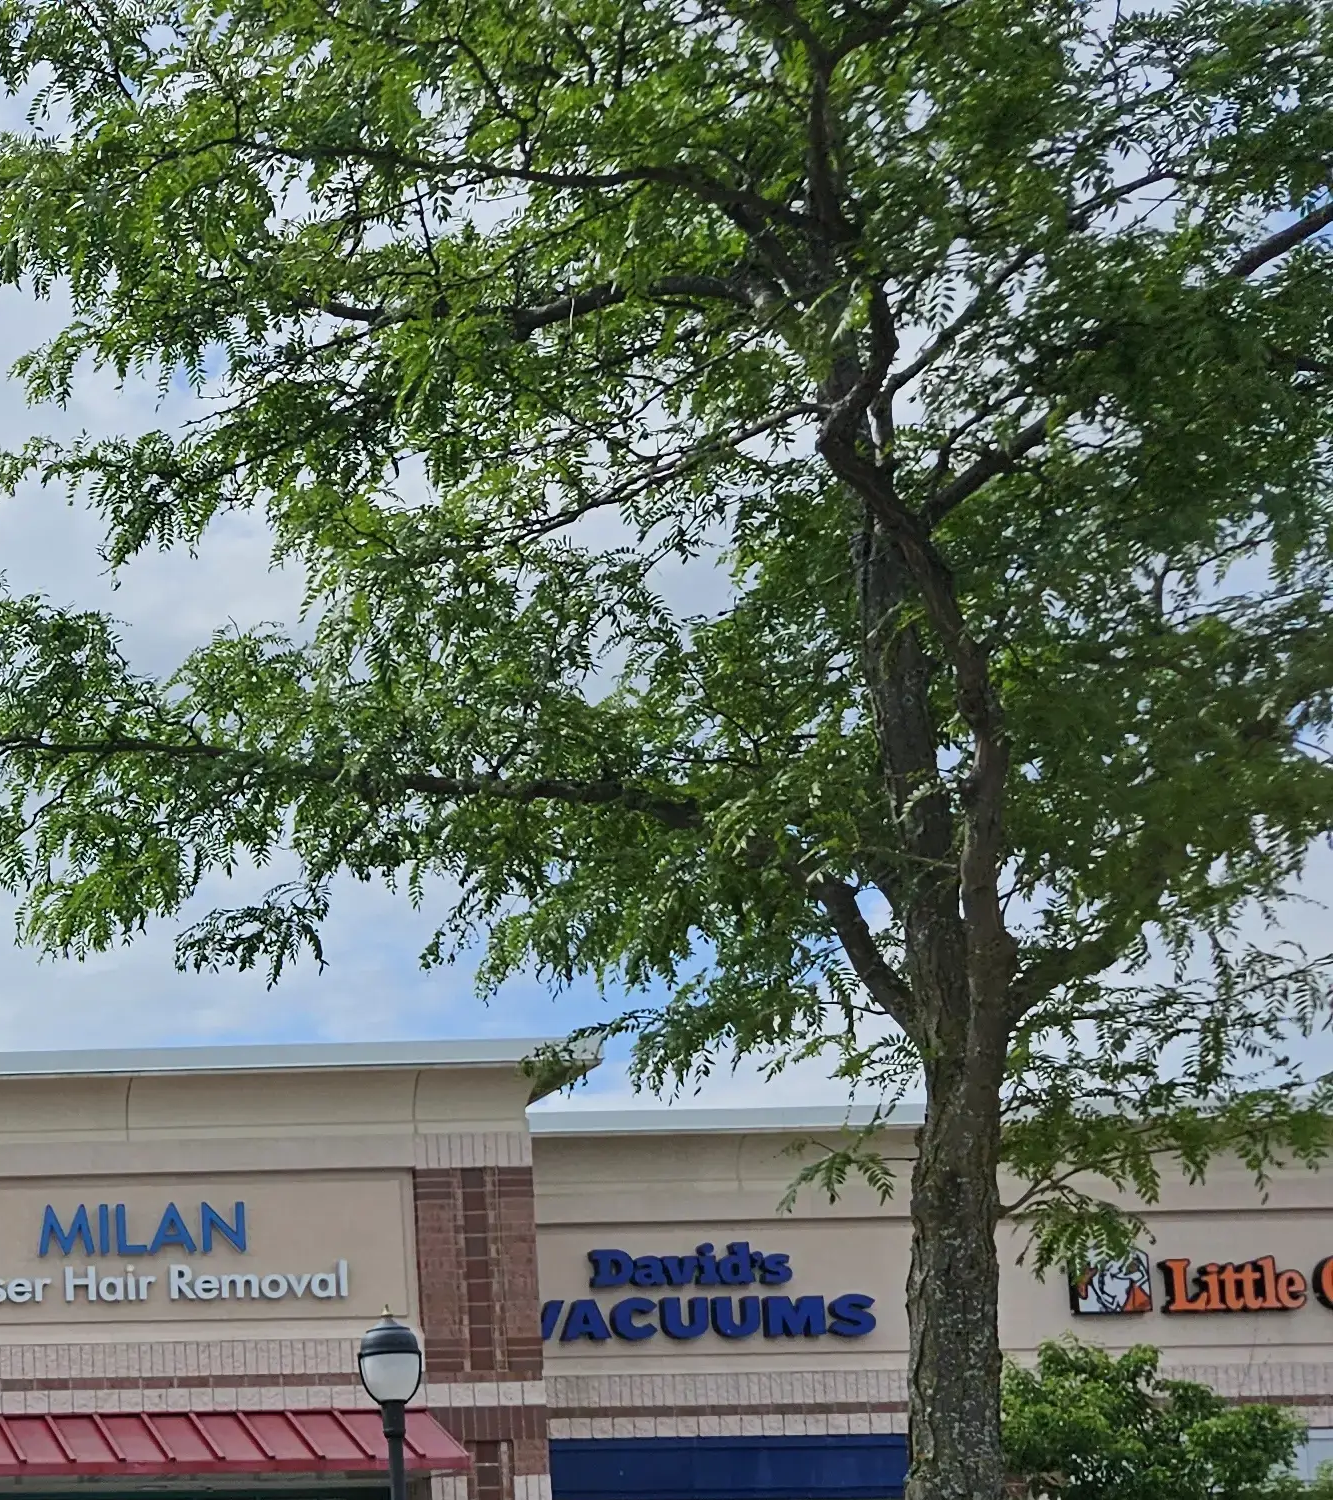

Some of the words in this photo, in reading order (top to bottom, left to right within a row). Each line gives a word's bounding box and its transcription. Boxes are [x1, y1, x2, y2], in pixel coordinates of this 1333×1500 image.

[38, 1201, 248, 1257] MILAN
[64, 1264, 157, 1302] Hair
[169, 1259, 350, 1301] Removal
[588, 1241, 793, 1288] David's
[1157, 1254, 1308, 1315] Little
[541, 1293, 877, 1342] VACUUMS
